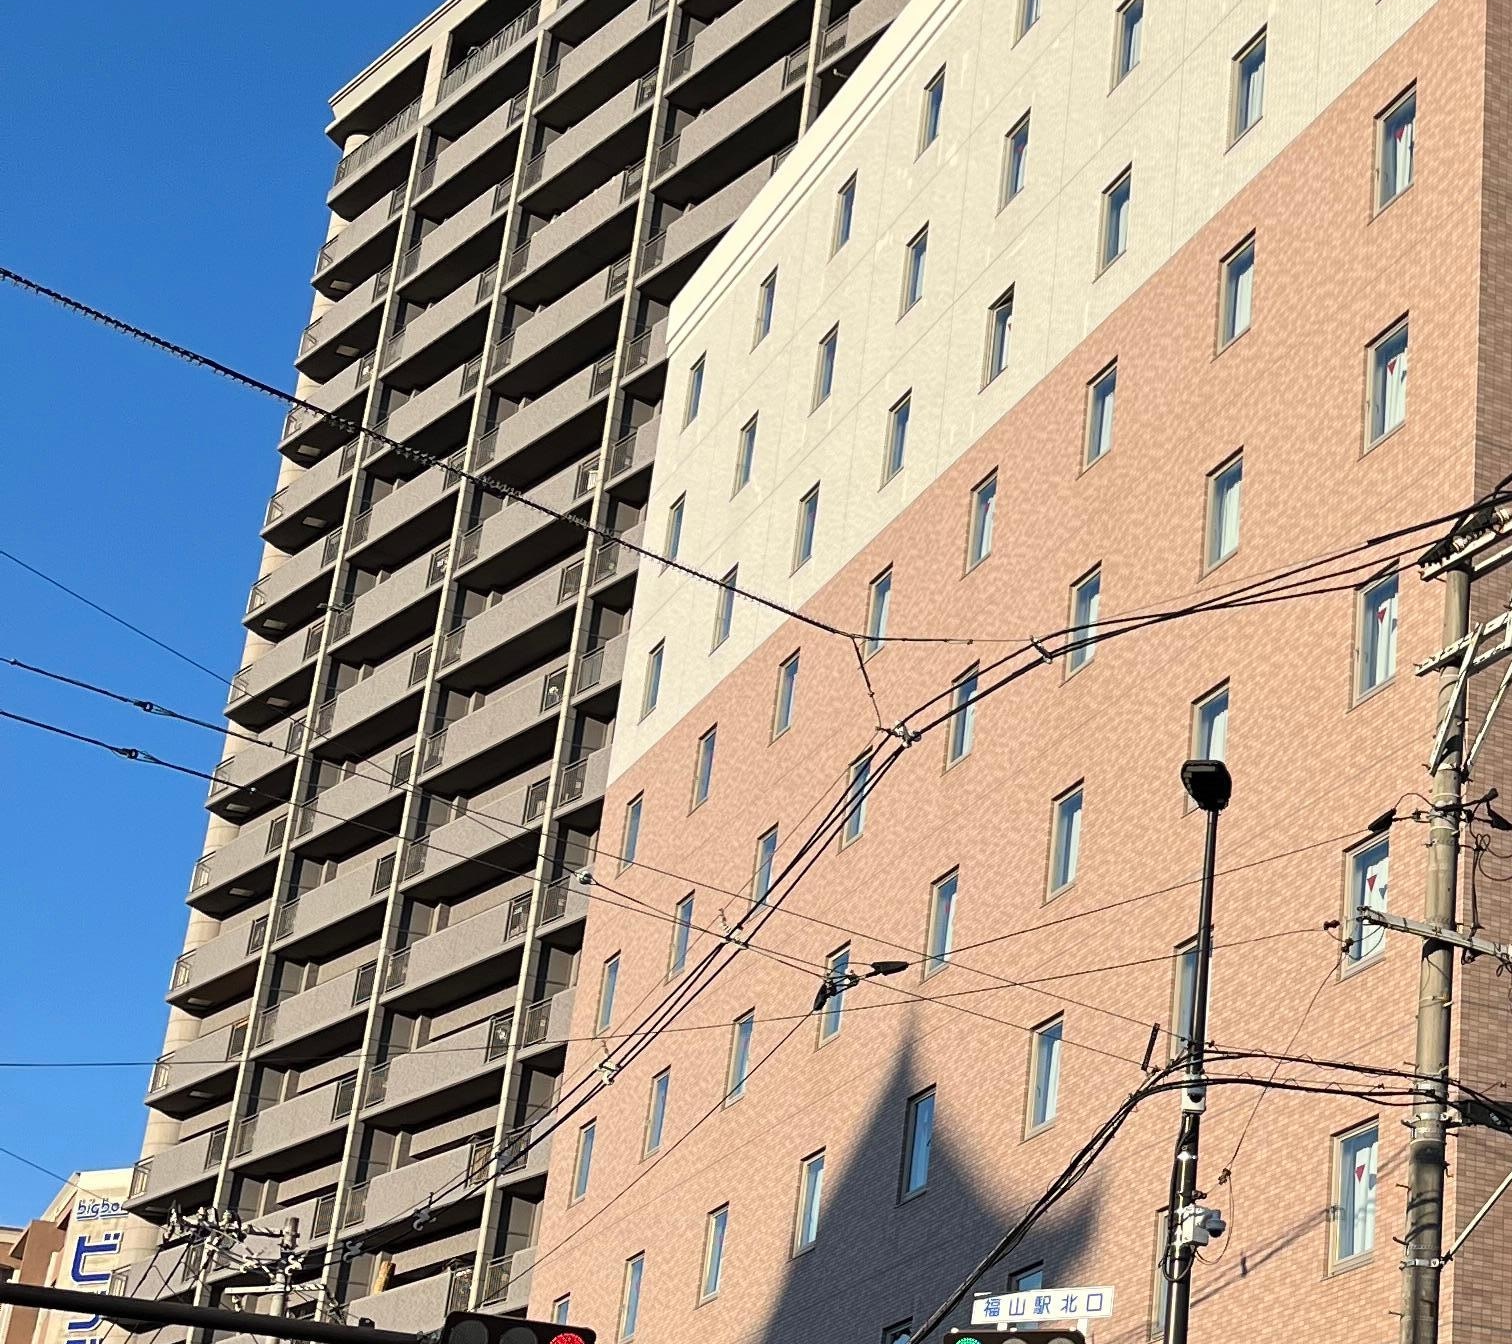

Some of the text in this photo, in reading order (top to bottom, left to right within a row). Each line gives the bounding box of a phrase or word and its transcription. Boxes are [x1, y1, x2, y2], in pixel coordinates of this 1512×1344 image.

[76, 1198, 129, 1219] bigbo
[984, 1293, 1104, 1317] 福山駅北口
